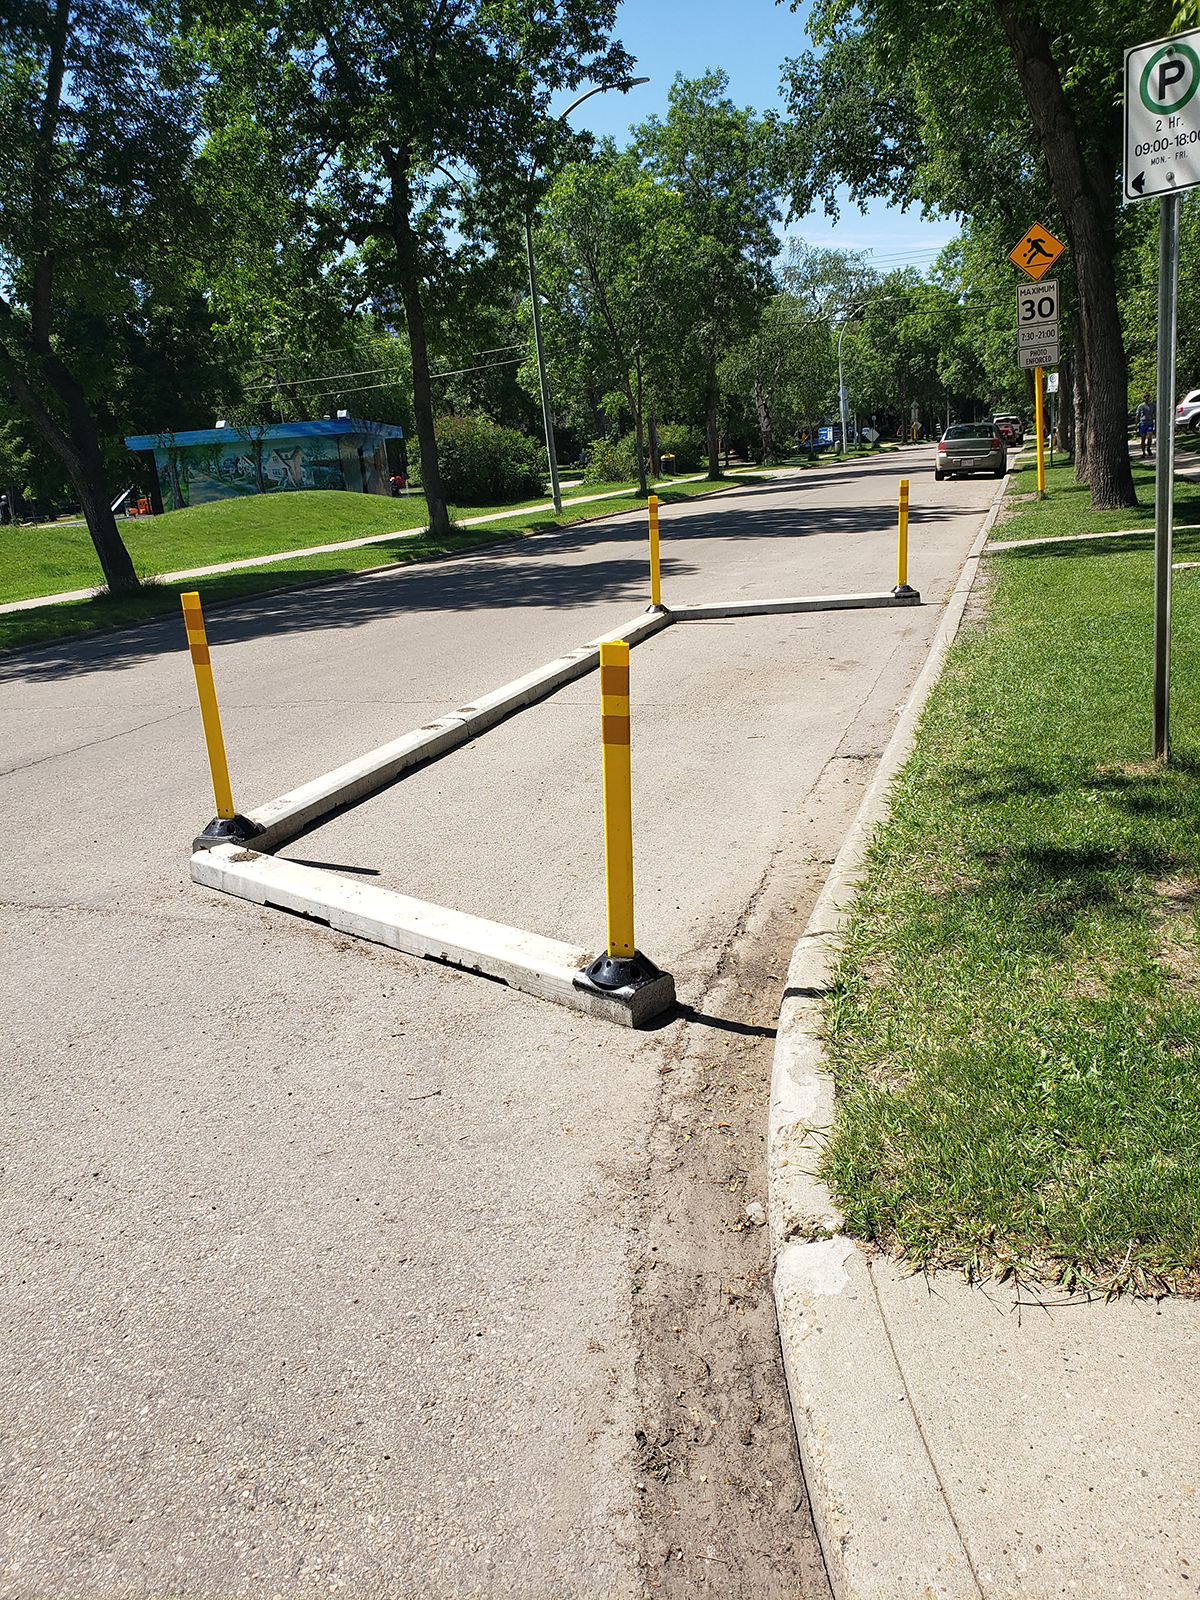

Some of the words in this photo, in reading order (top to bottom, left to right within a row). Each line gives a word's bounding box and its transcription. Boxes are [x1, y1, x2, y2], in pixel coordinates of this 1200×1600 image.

[1159, 60, 1185, 100] P
[1155, 119, 1162, 132] 2
[1168, 116, 1184, 129] Hr.
[1020, 285, 1055, 296] MAXIMUM
[1021, 296, 1055, 321] 30
[1030, 348, 1048, 357] PHOTO
[1026, 355, 1053, 365] ENFORCED
